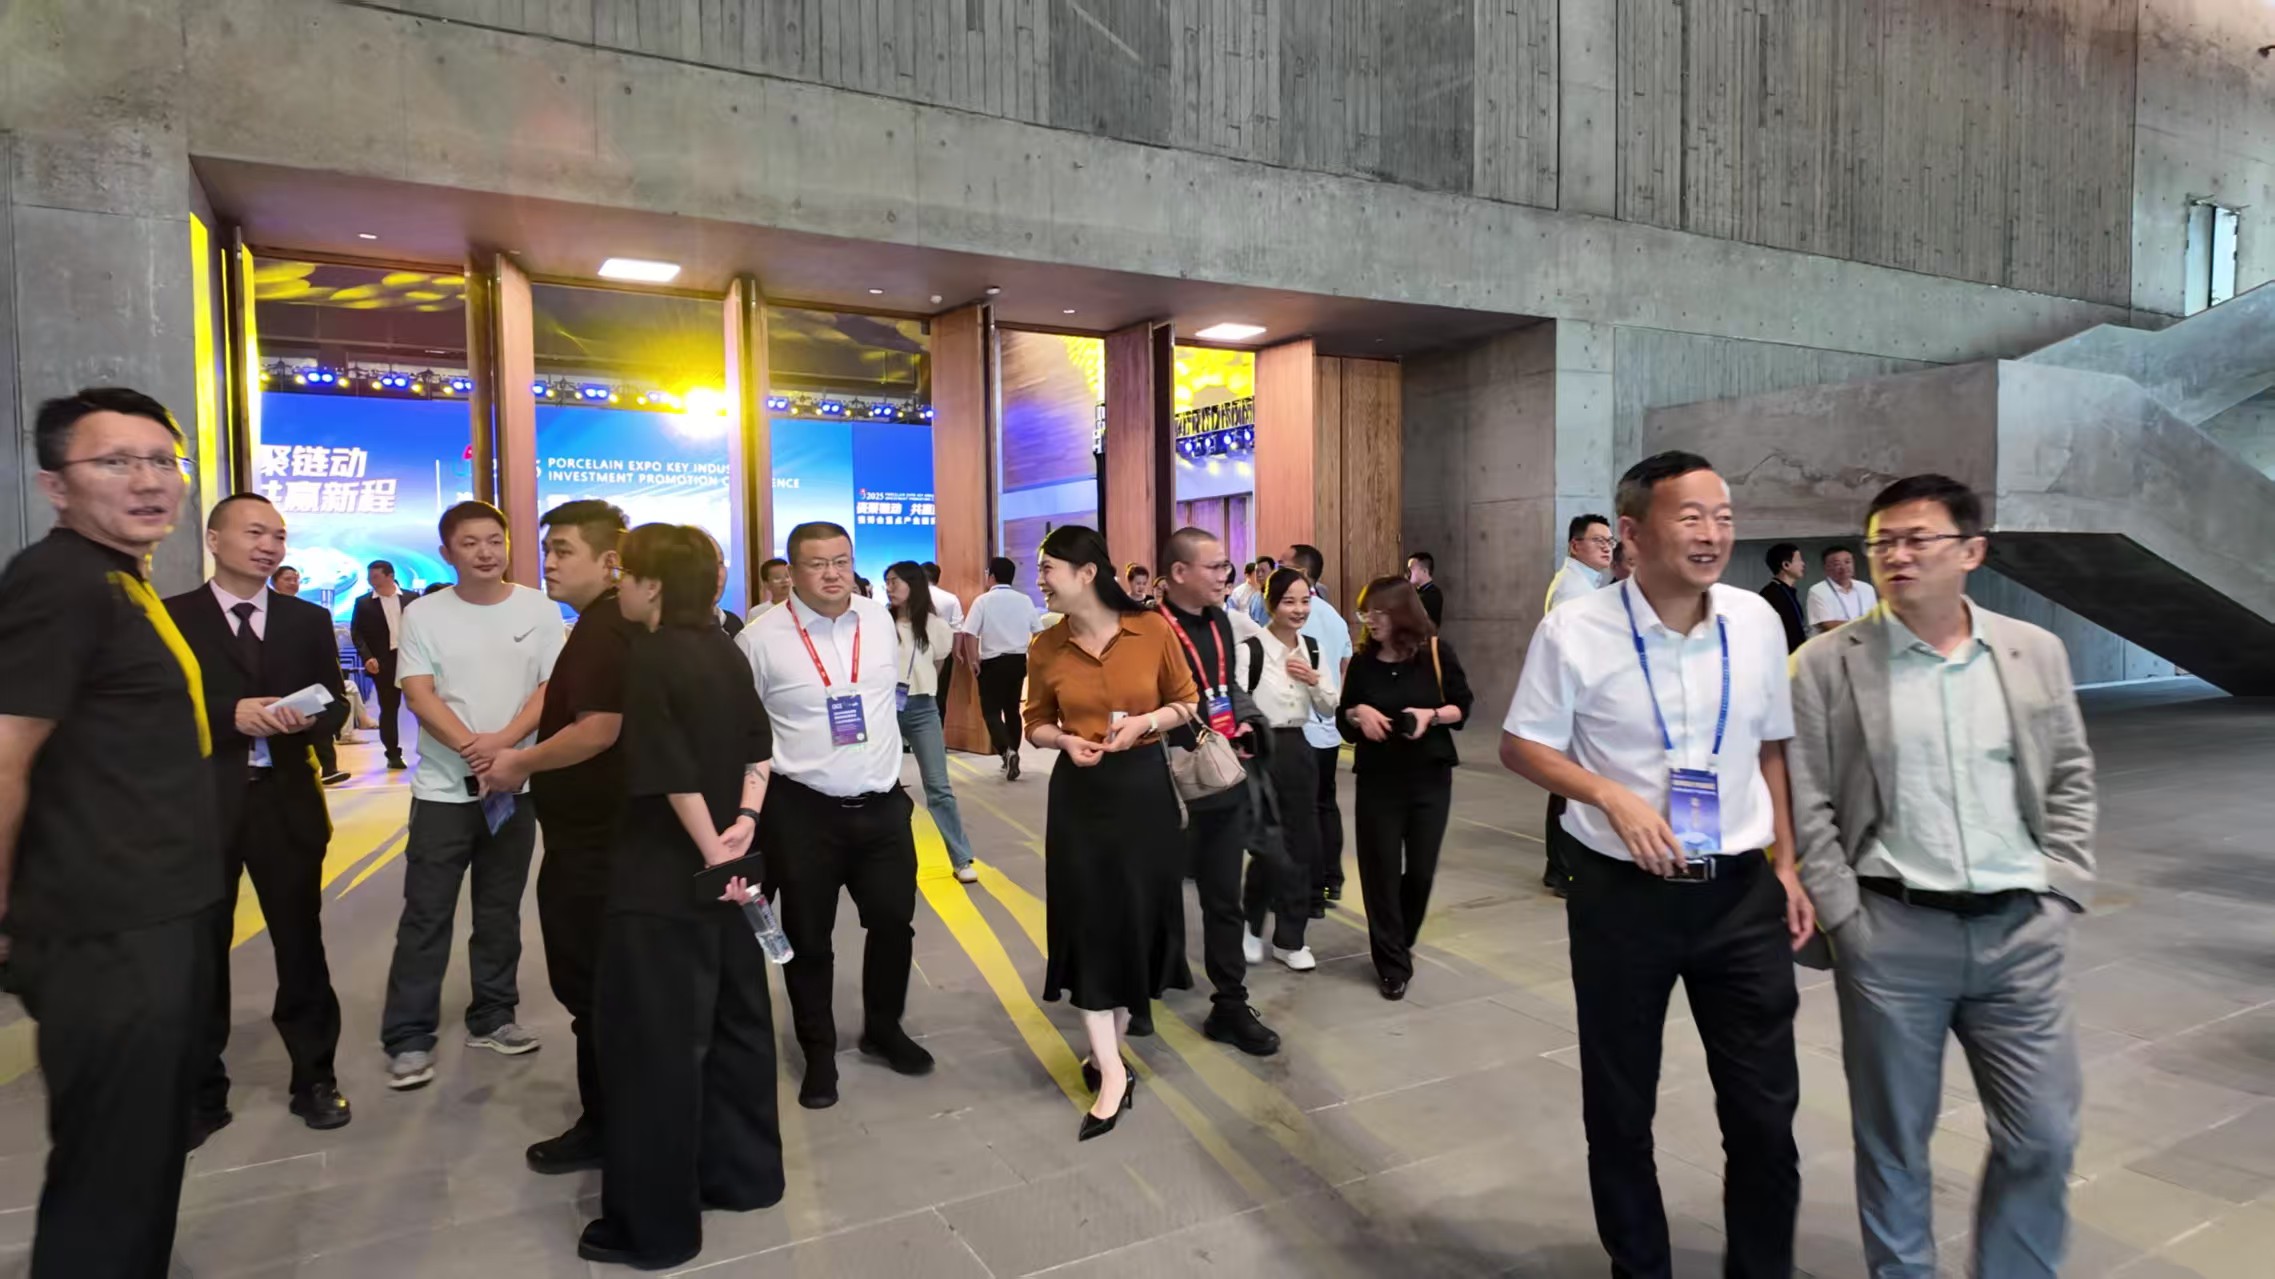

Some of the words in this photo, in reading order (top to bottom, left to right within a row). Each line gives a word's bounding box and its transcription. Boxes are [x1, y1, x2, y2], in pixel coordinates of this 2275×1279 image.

[547, 457, 624, 470] PORCELAIN
[628, 460, 662, 472] EXPO
[666, 462, 689, 472] KEY
[548, 470, 634, 483] INVESTMENT
[638, 473, 717, 486] PROMOTION
[866, 492, 884, 500] 2025
